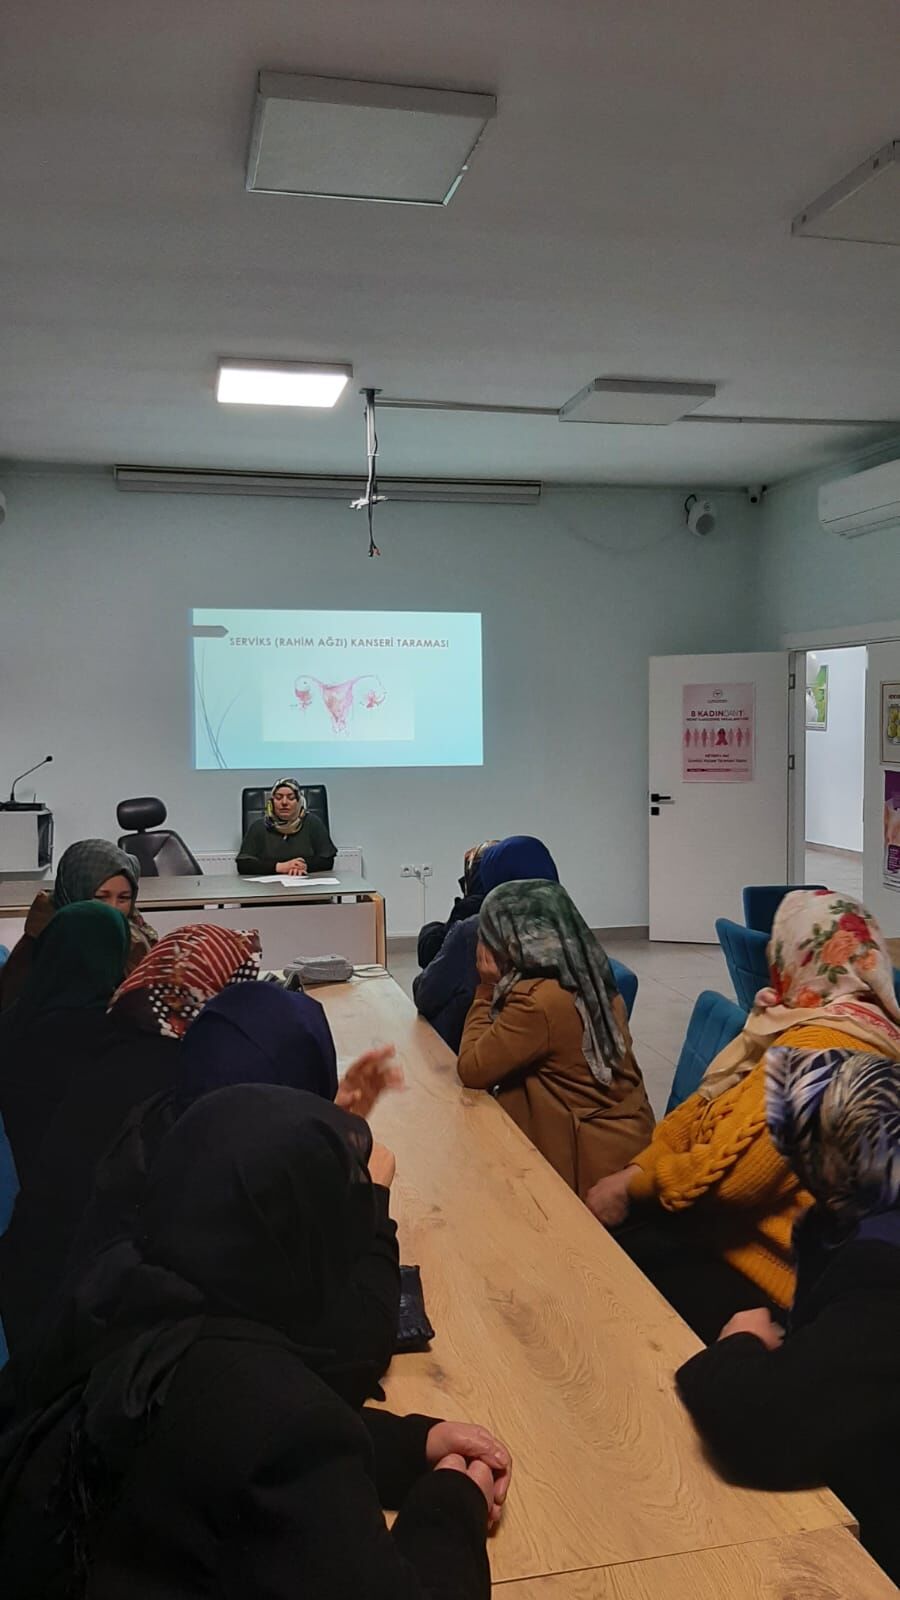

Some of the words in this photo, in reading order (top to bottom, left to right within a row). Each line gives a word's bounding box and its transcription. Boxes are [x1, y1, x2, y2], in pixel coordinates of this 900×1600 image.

[229, 637, 271, 646] SERVİKS
[275, 636, 314, 648] (RAHİM
[318, 636, 347, 648] AĞZI)
[351, 637, 393, 647] KANSERİ
[397, 638, 449, 648] TARAMASI
